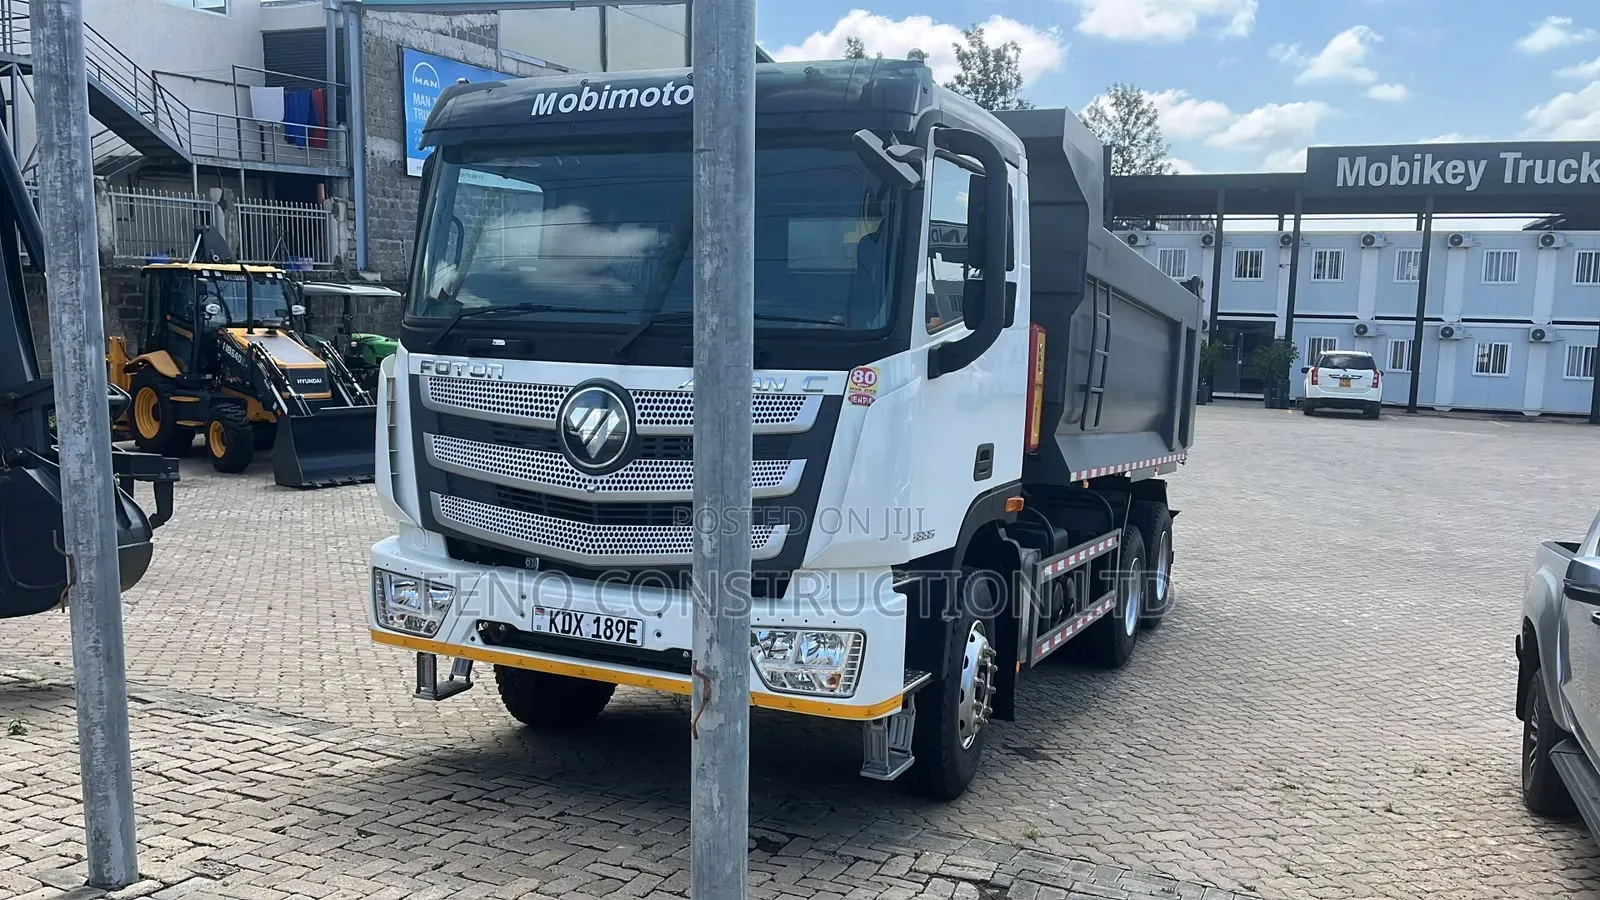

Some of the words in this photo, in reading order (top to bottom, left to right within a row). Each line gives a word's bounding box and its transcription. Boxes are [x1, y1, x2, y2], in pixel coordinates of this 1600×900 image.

[414, 76, 438, 89] MAN
[412, 92, 431, 107] MAN
[1336, 153, 1488, 192] Mobikey
[1499, 151, 1600, 184] Truck
[420, 359, 504, 379] FOTON
[852, 369, 876, 385] 80
[802, 375, 829, 393] C
[549, 610, 584, 637] KDX
[591, 616, 639, 645] 189E
